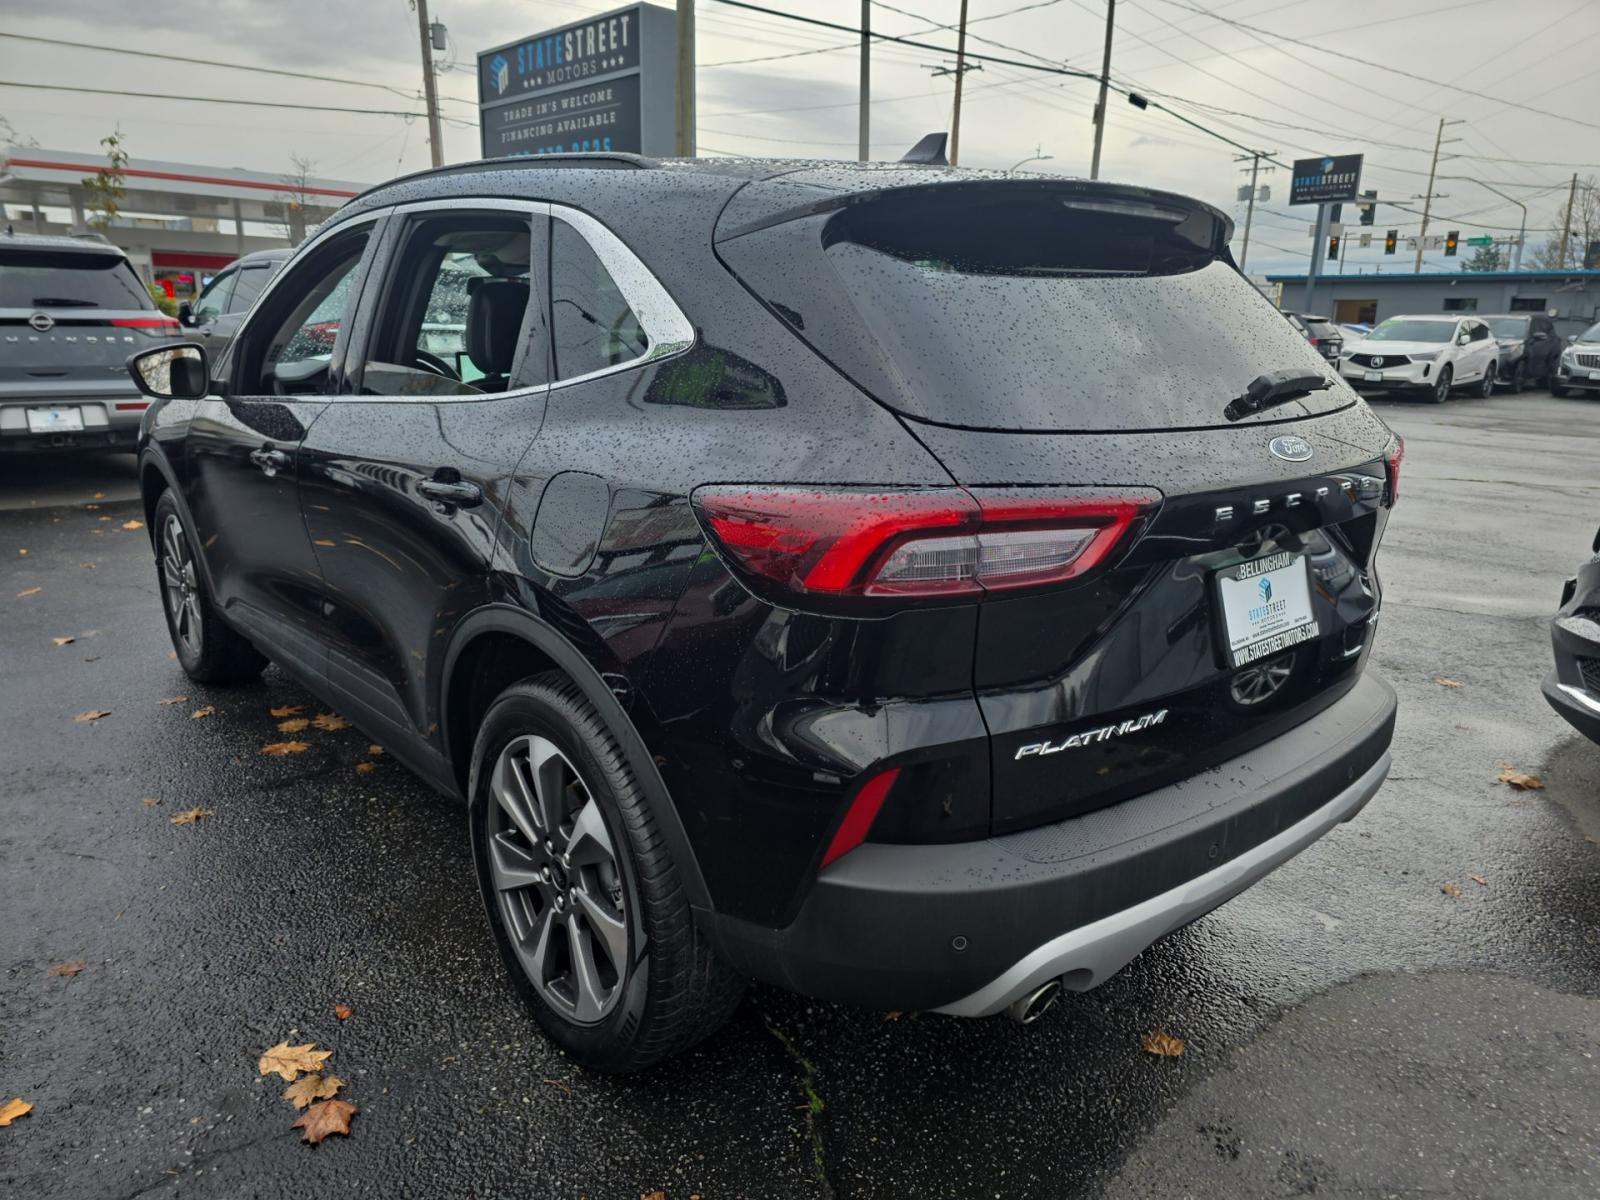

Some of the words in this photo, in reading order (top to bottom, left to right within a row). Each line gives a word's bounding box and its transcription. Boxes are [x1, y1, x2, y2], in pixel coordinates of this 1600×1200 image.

[546, 59, 597, 84] MOTORS
[503, 106, 532, 122] TRADE
[536, 101, 557, 115] IN'S
[561, 89, 612, 109] WELCOME
[501, 123, 553, 143] FINANCING
[556, 112, 616, 133] AVAILABLE
[1239, 551, 1290, 580] BELLINGHAM
[1233, 622, 1319, 667] WWW.STATESTREETMOTORS.COM
[1014, 709, 1169, 760] PLATINUM
